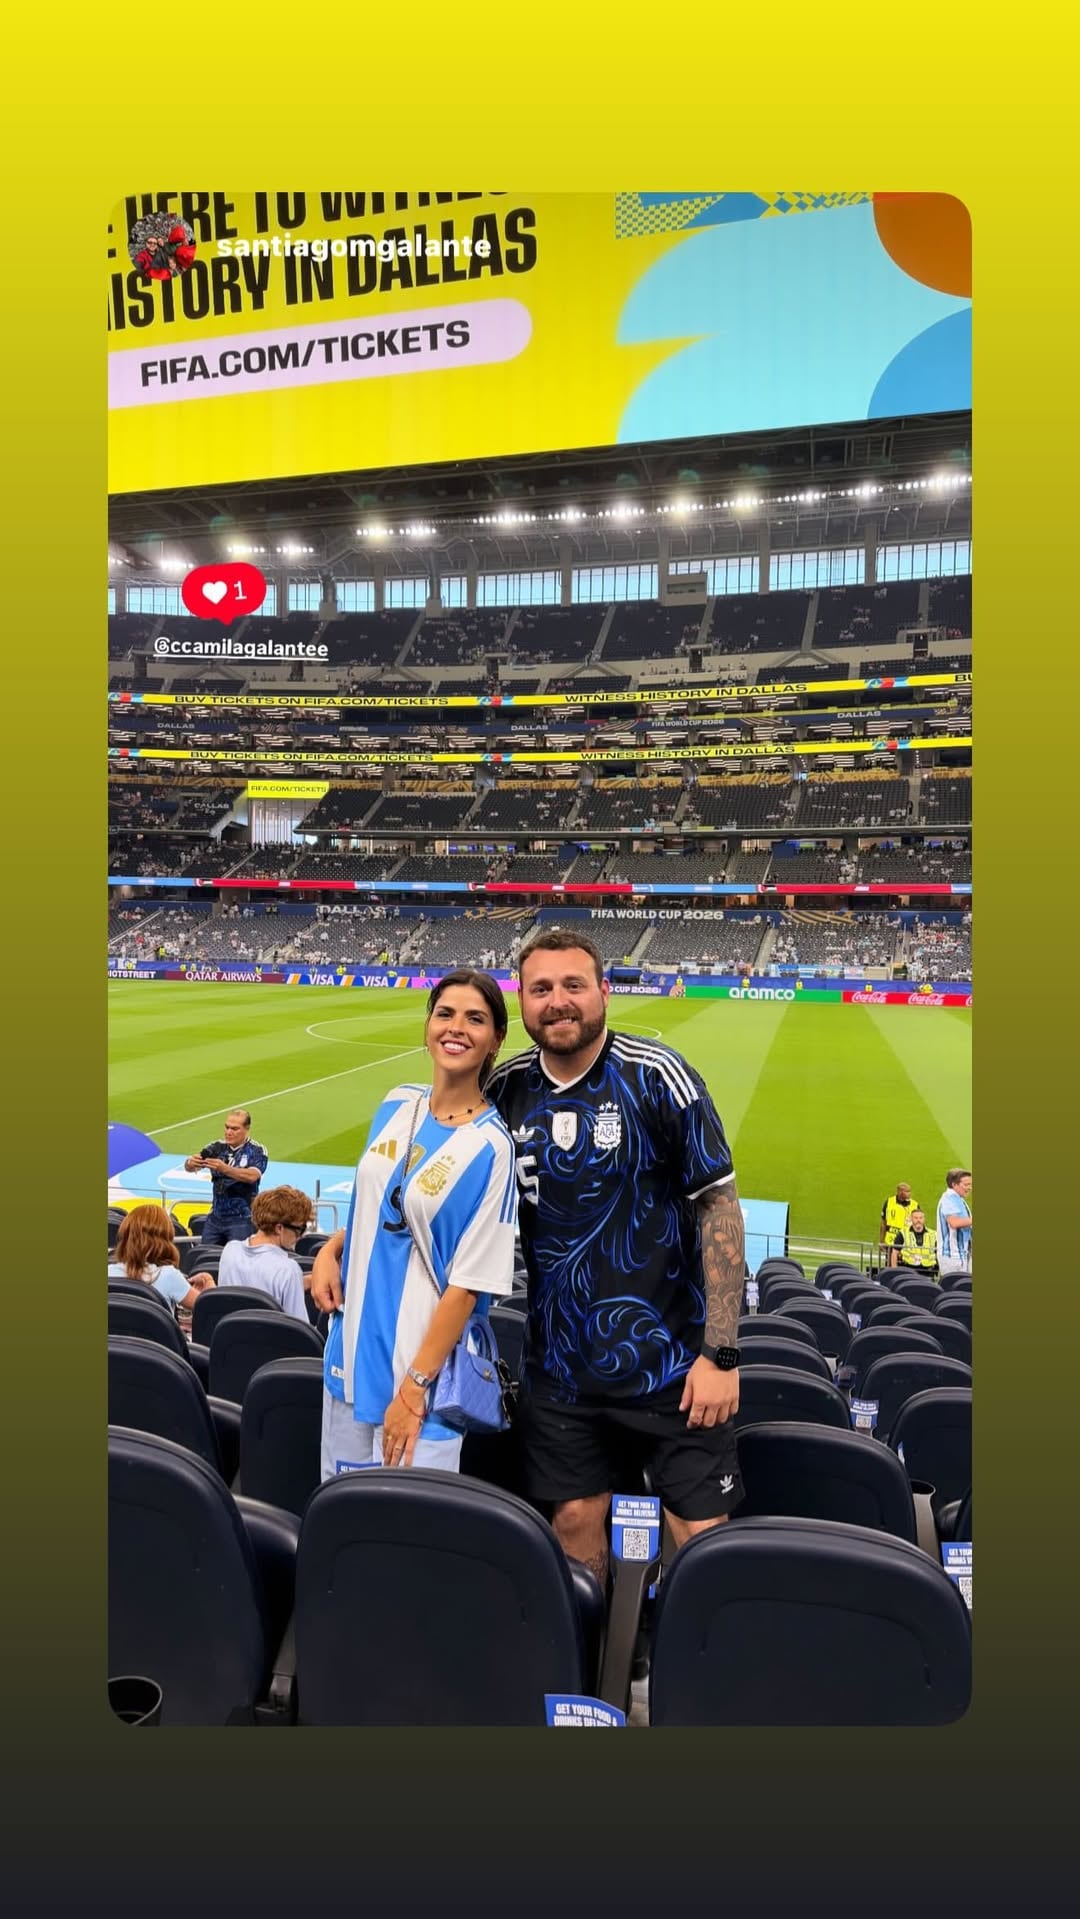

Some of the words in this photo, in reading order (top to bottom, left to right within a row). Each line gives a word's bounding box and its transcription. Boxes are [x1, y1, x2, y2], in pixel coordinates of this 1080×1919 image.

[108, 248, 271, 332] ISTORY
[284, 240, 335, 305] IN
[346, 207, 537, 297] DALLAS
[140, 320, 470, 387] FIFA.COM/TICKETS
[565, 693, 637, 702] WITNESS
[640, 689, 711, 700] HISTORY
[716, 687, 733, 696] IN
[736, 684, 807, 695] DALLAS
[174, 696, 207, 704] BUY
[210, 696, 275, 705] TICKETS
[277, 697, 300, 705] ON
[304, 697, 449, 706] FIFA.COM/TICKETS
[837, 710, 881, 719] DALLAS
[190, 751, 220, 759] BUY
[222, 752, 280, 760] TICKETS
[306, 753, 434, 761] FIFA.COM/TICKETS
[580, 752, 645, 760] WITNESS
[647, 749, 711, 759] HISTORY
[715, 747, 730, 756] IN
[733, 745, 796, 755] DALLAS
[250, 785, 327, 793] FIFA.COM/TICKETS
[591, 909, 615, 919] FIFA
[616, 909, 656, 920] WORLD
[658, 910, 681, 919] CUP
[682, 911, 724, 920] 2026
[185, 970, 218, 981] QATAR
[220, 971, 262, 983] AIRWAYS
[308, 974, 335, 985] VISA
[363, 975, 389, 987] VISA
[614, 985, 631, 993] CUP
[728, 987, 796, 1000] aramco
[555, 1703, 571, 1715] GET
[571, 1703, 593, 1717] YOUR
